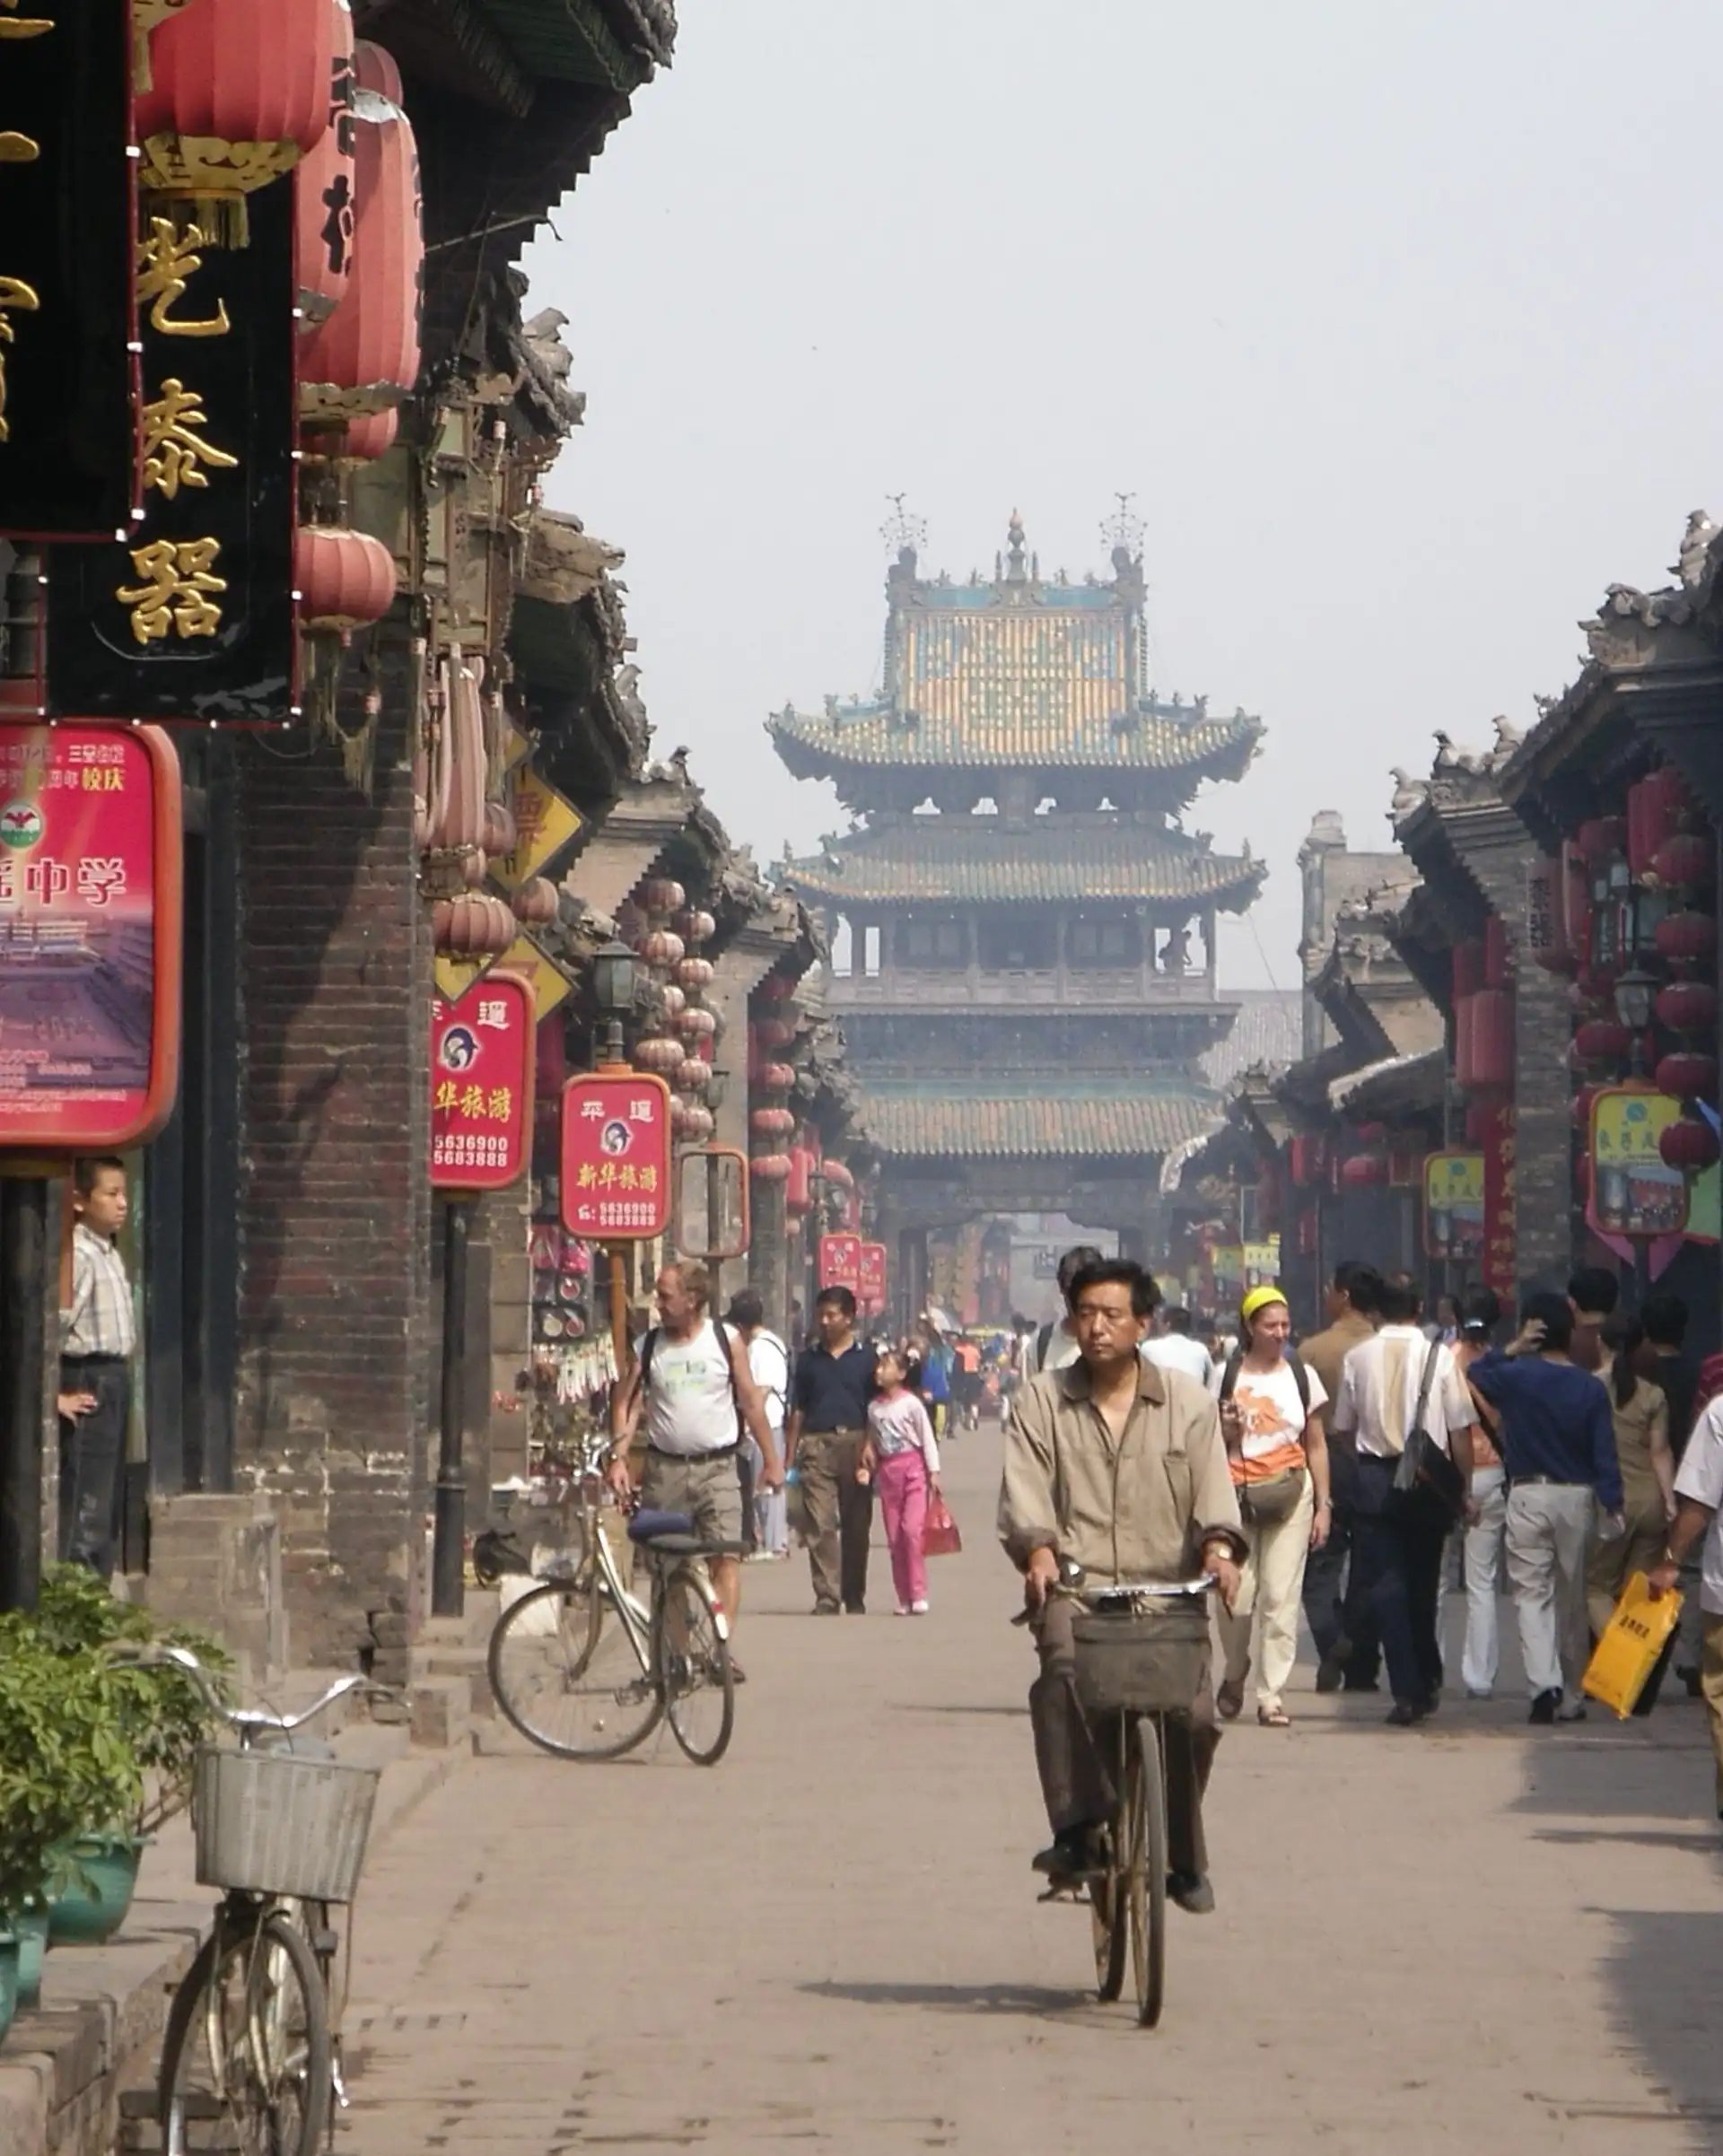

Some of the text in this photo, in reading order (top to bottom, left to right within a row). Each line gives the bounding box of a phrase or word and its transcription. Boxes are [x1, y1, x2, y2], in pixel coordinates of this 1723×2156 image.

[433, 1080, 512, 1123] 华旅游
[434, 1134, 508, 1152] 5636900
[576, 1161, 657, 1192] 新华旅游
